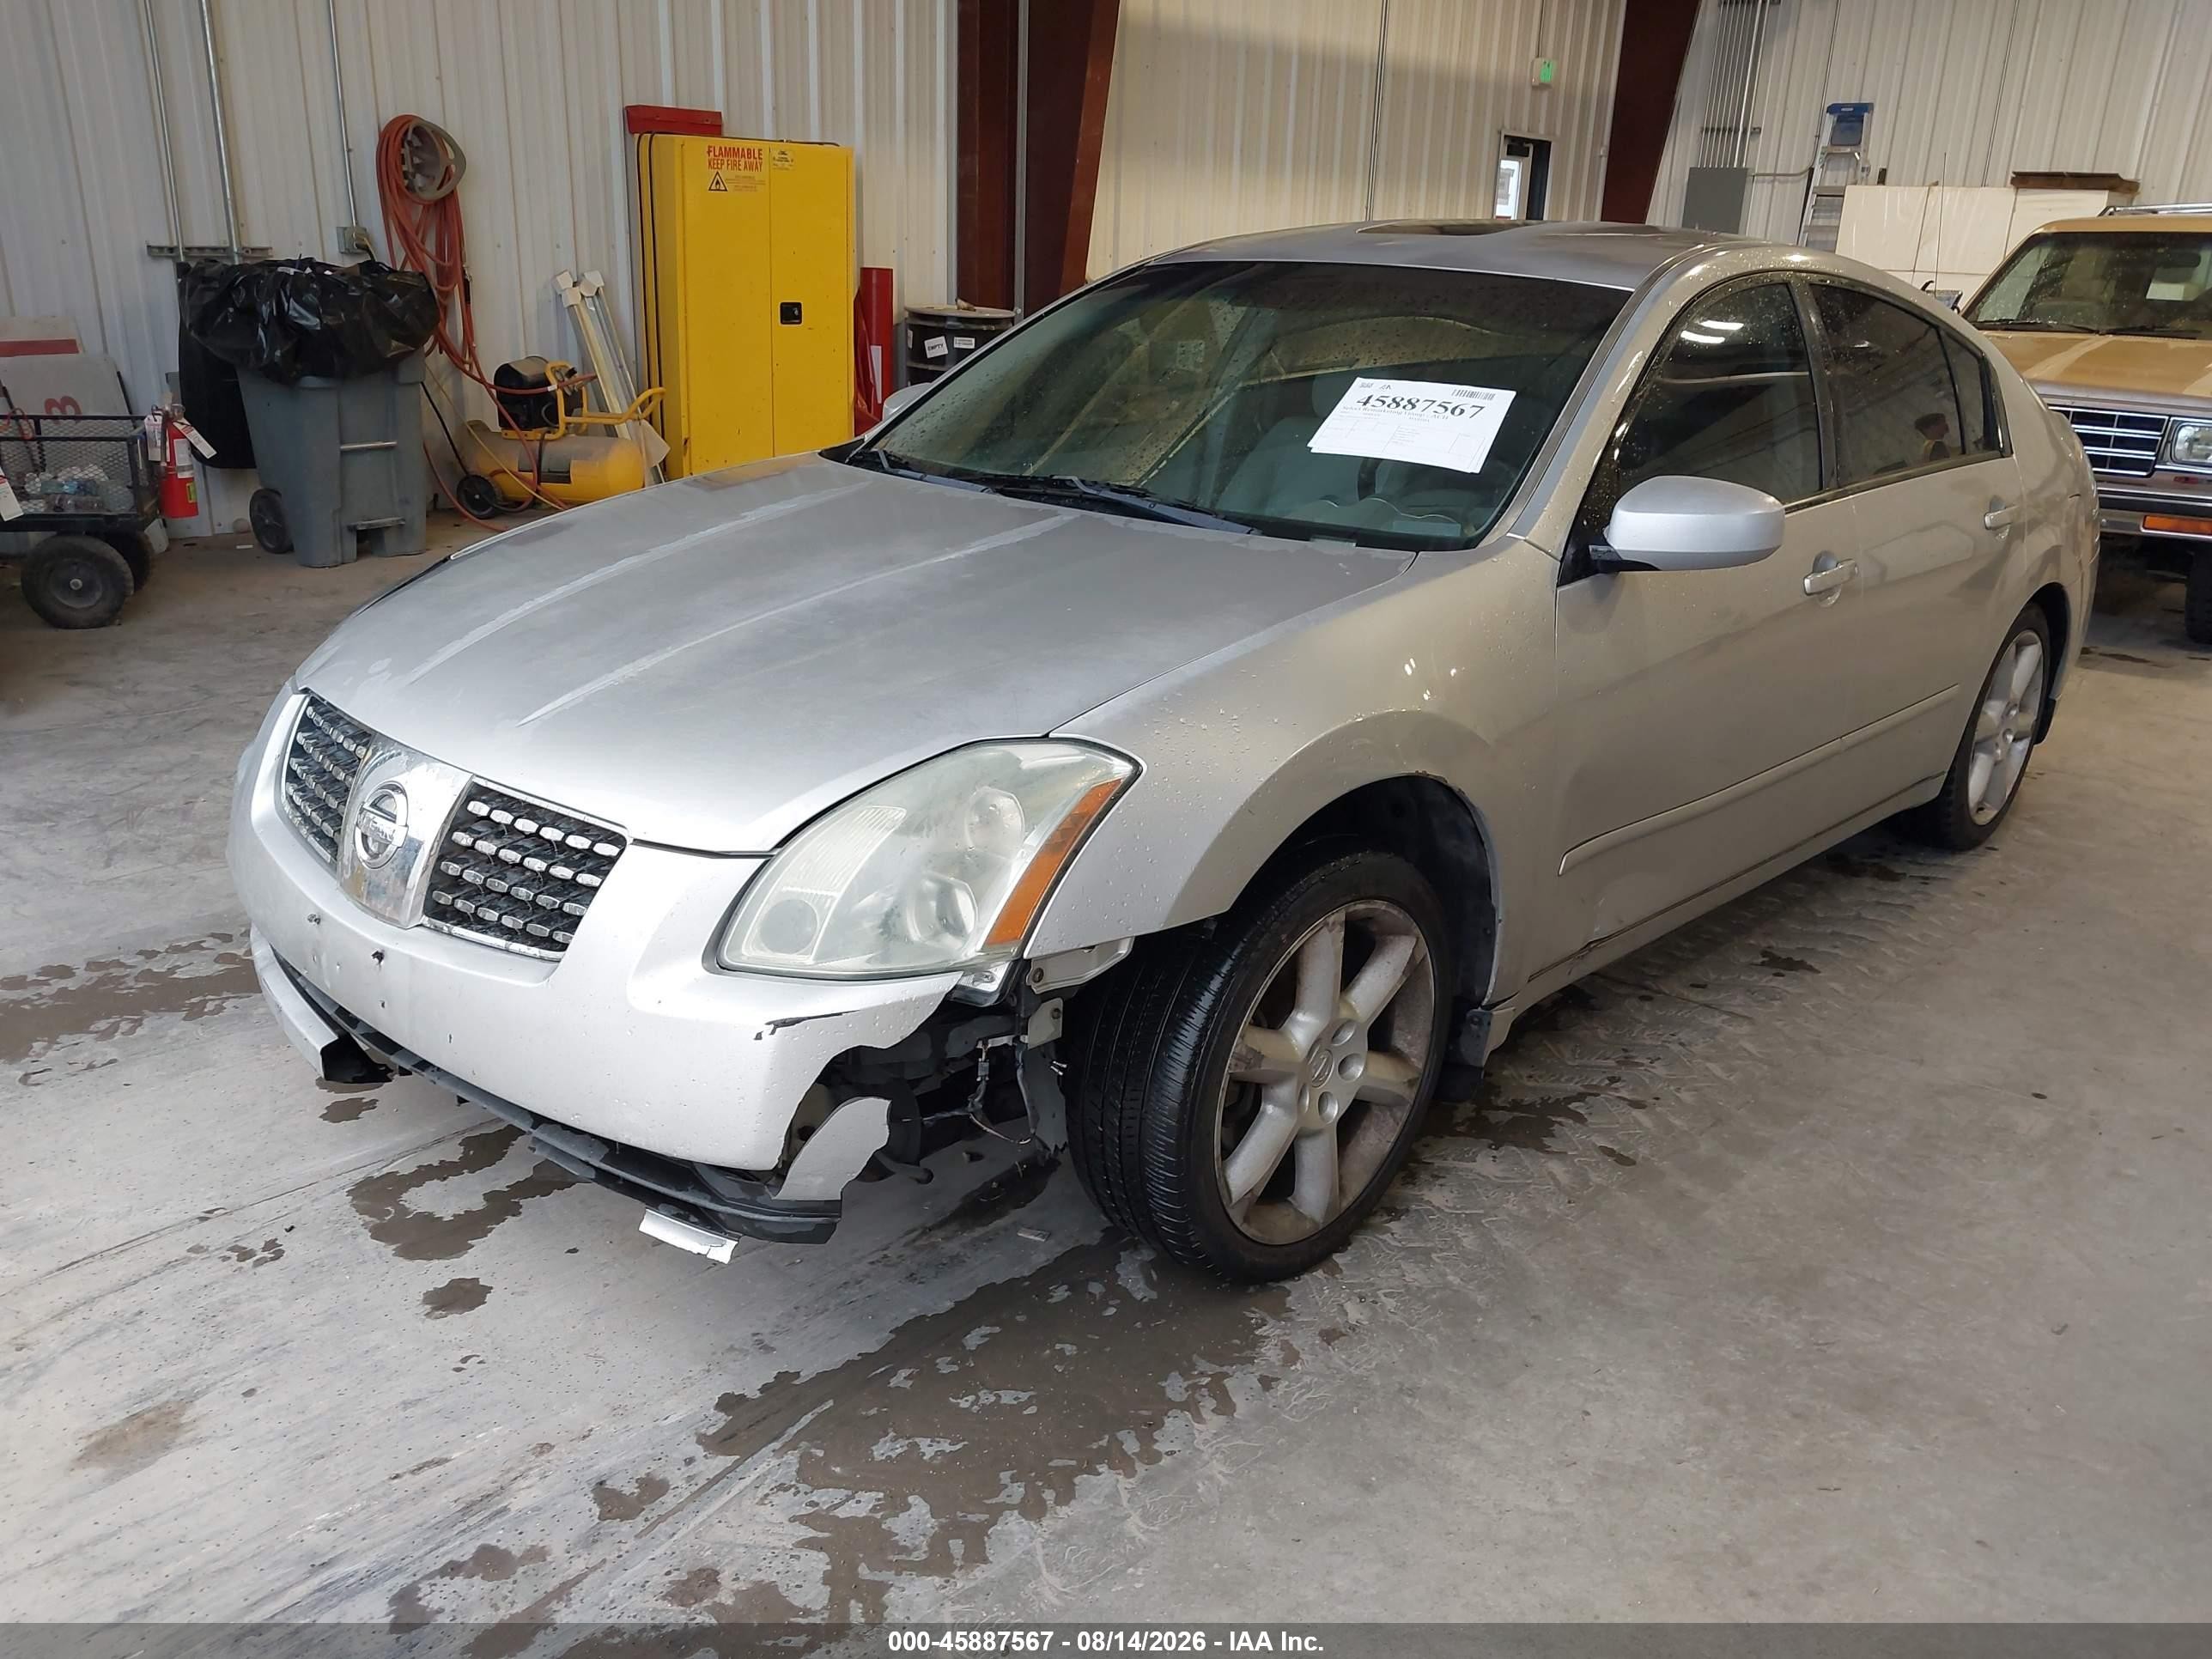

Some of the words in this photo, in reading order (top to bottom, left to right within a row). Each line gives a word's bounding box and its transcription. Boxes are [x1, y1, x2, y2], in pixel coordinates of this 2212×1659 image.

[707, 145, 763, 161] FLAMMABLE
[708, 158, 725, 170] KEEP
[726, 159, 742, 172] FIRE
[744, 161, 763, 173] AWAY
[1356, 394, 1486, 419] 45887567
